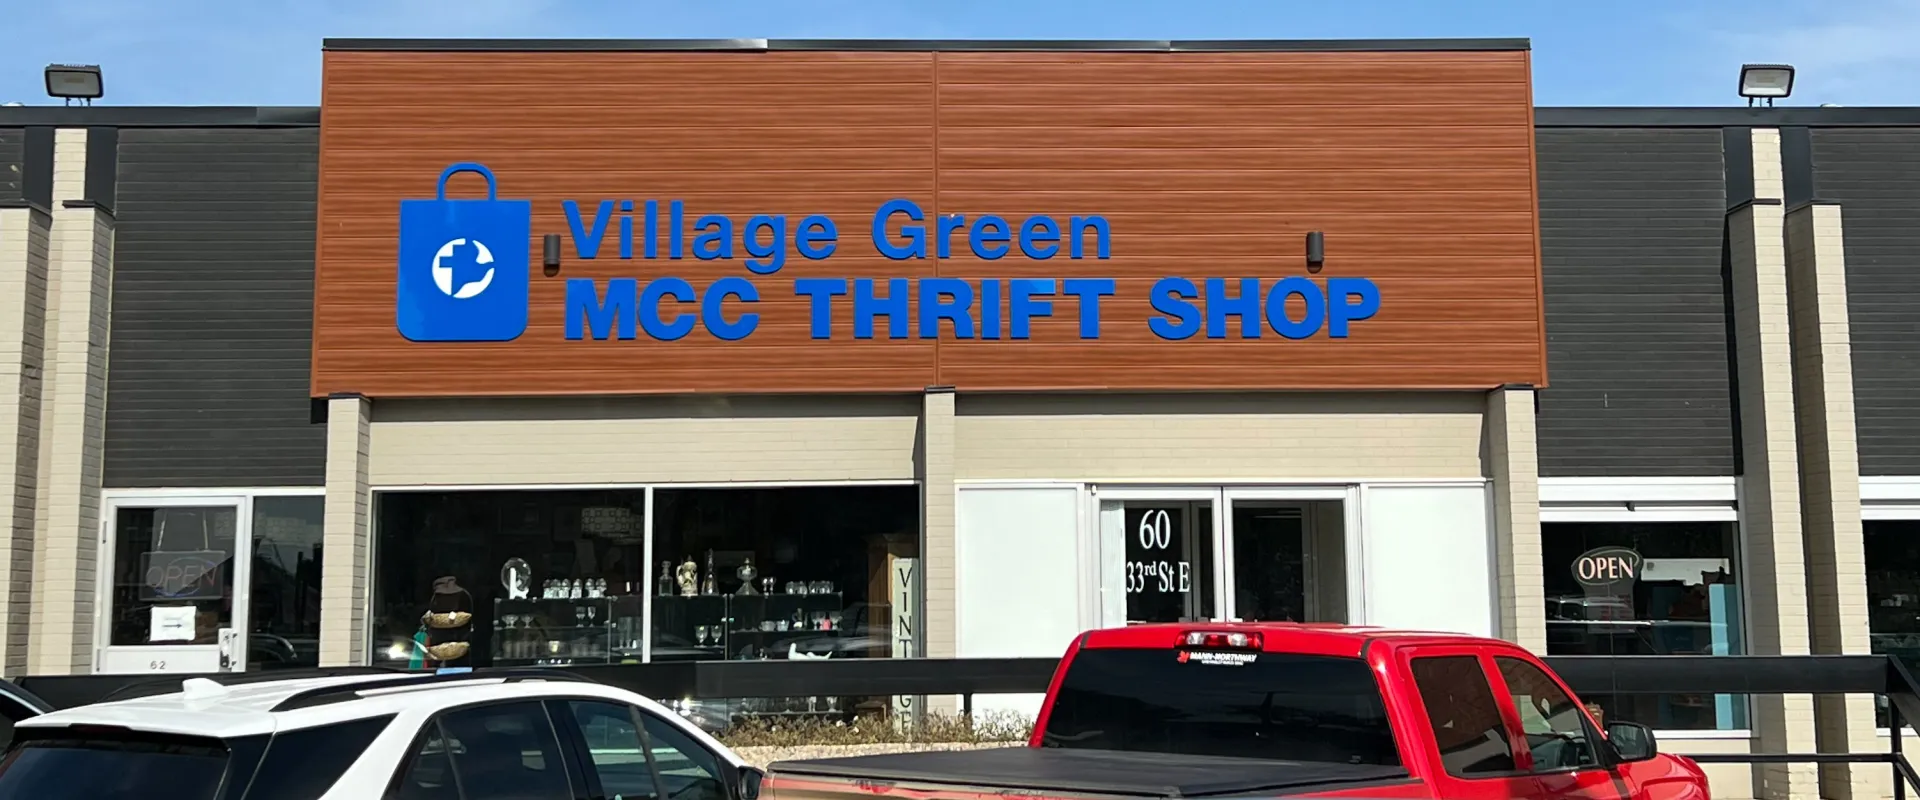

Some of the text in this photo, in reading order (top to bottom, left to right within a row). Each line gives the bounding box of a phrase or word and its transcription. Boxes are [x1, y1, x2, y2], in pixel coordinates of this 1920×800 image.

[562, 199, 1111, 274] Village Green
[564, 276, 1381, 341] MCC THRIFT SHOP
[1140, 509, 1171, 549] 60
[145, 565, 218, 588] OPEN
[1126, 560, 1190, 593] 33rd St E
[1578, 556, 1634, 579] OPEN
[898, 567, 913, 732] VINTGE
